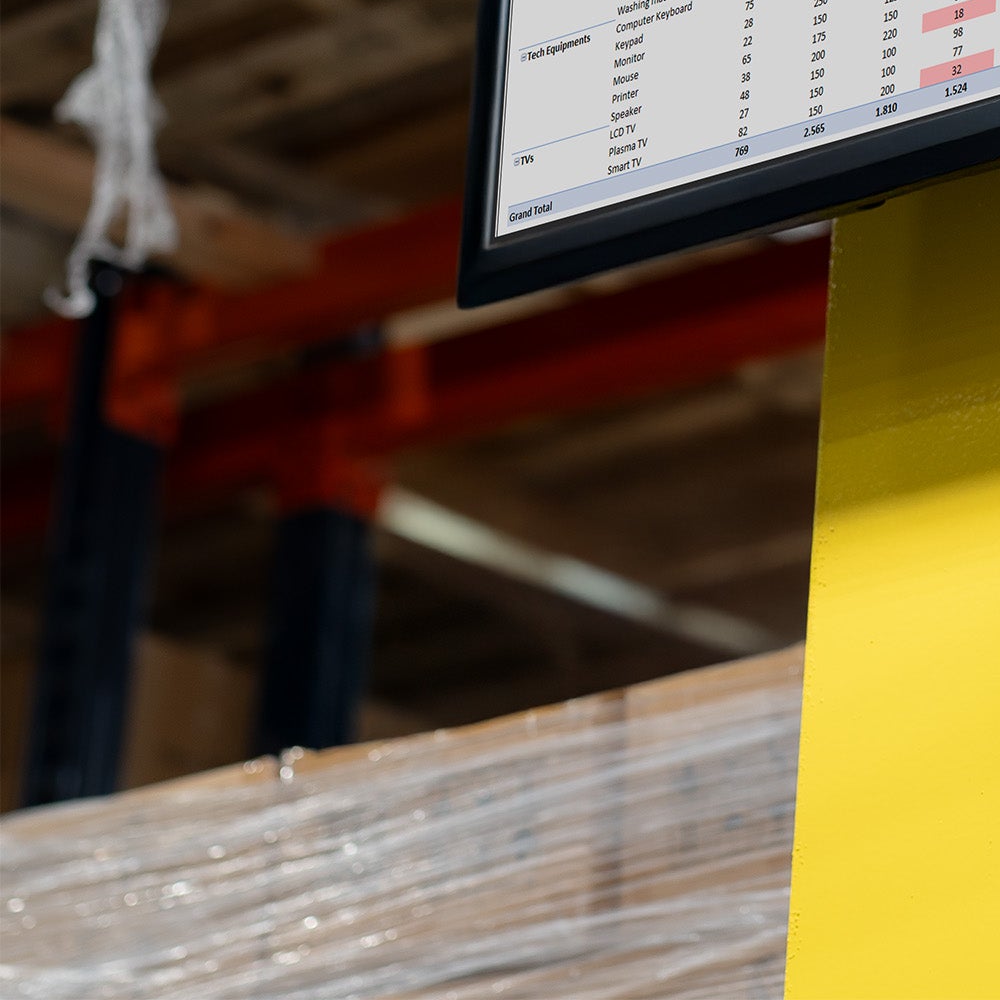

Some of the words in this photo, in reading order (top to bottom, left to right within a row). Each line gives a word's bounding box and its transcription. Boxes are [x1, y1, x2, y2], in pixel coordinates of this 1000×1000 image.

[615, 14, 655, 33] Computer
[655, 0, 693, 21] Keyboard
[526, 46, 545, 61] Tech
[545, 34, 591, 56] Equipments
[614, 32, 643, 51] Keypad
[613, 51, 645, 68] Monitor
[612, 71, 639, 86] Mouse
[611, 88, 639, 104] Printer
[944, 81, 967, 98] 1.524
[610, 105, 642, 123] Speaker
[875, 101, 898, 117] 1.810
[609, 126, 624, 140] LCD
[625, 123, 636, 134] TV
[802, 121, 825, 138] 2.565
[608, 141, 636, 157] Plasma
[636, 137, 648, 148] TV
[734, 144, 749, 157] 769
[520, 153, 534, 165] TVs
[607, 160, 630, 175] Smart
[630, 156, 642, 168] TV
[508, 206, 532, 222] Grand
[532, 200, 553, 215] Total
